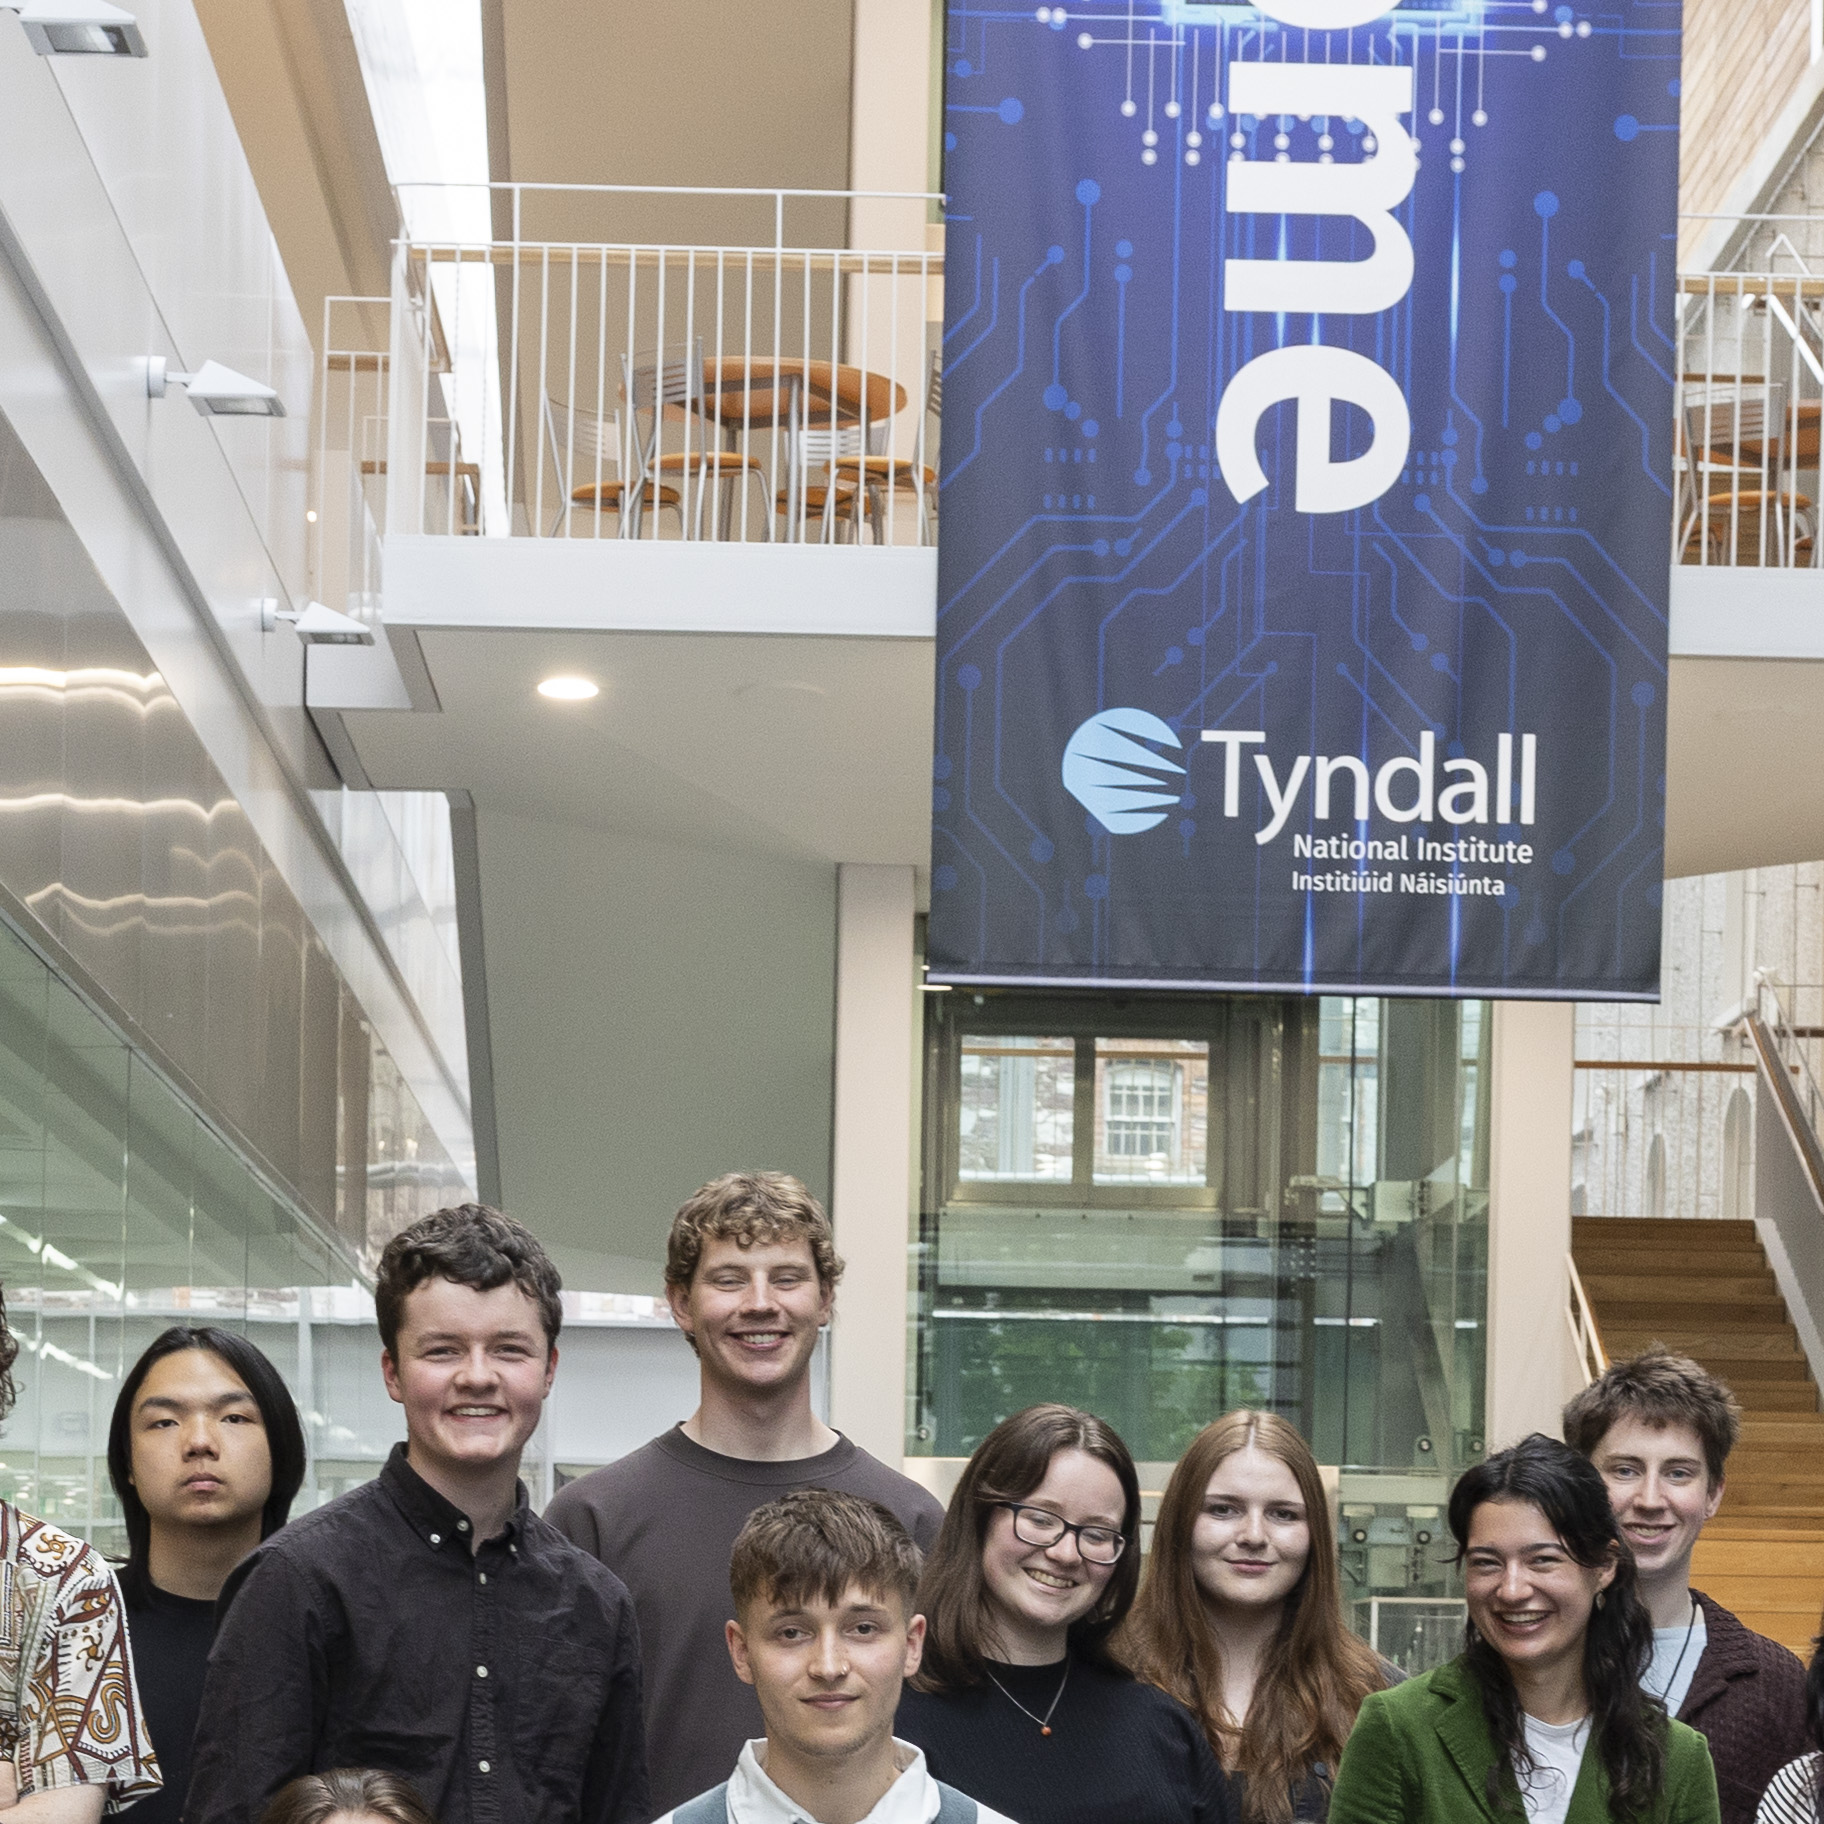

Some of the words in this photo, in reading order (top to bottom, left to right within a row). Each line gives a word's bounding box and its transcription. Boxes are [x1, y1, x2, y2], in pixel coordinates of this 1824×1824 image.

[1216, 0, 1415, 514] me
[1201, 729, 1537, 845] Tyndall
[1292, 870, 1393, 893] Institiúid
[1400, 871, 1505, 896] Náisiúnta
[1293, 832, 1409, 861] National
[1417, 835, 1533, 864] Institute
